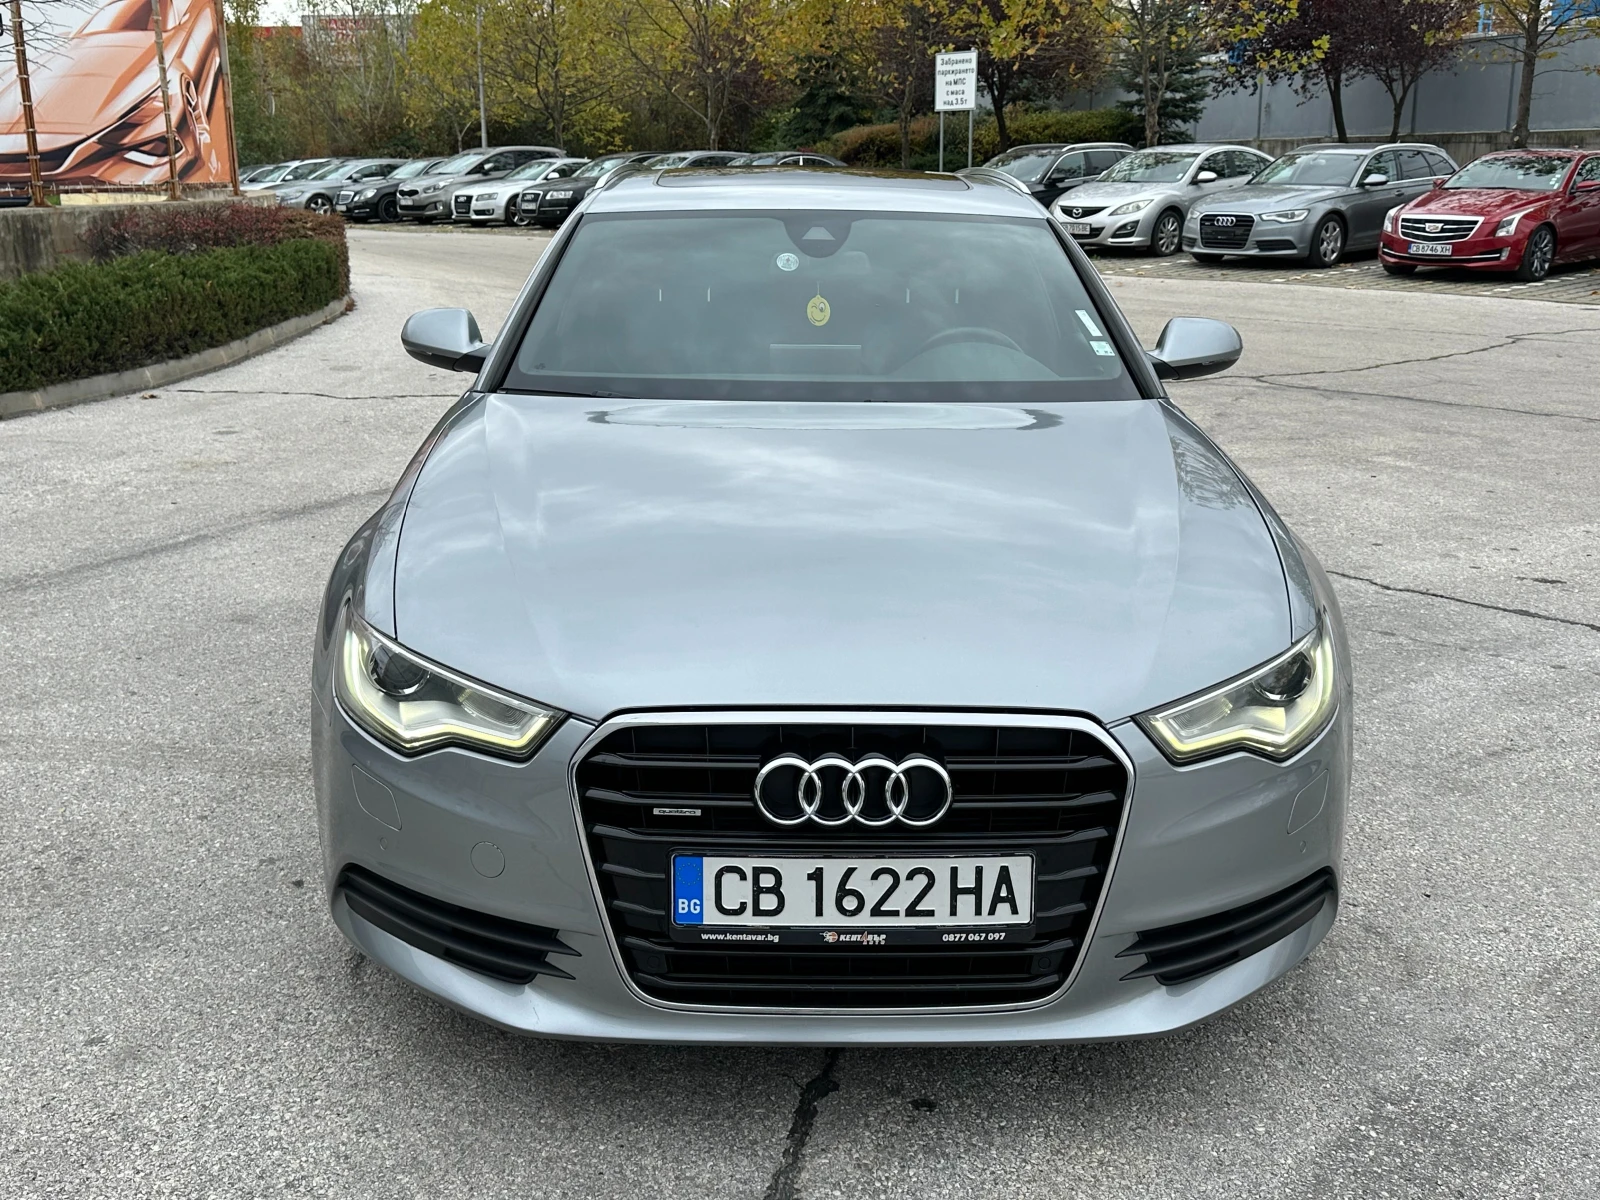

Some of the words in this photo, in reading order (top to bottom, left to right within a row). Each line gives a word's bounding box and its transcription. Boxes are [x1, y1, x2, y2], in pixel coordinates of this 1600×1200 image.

[940, 57, 972, 66] Забранено
[938, 68, 974, 77] паркирането
[953, 78, 966, 86] МПС
[1412, 245, 1420, 253] CB
[1421, 245, 1439, 254] 8746
[1440, 246, 1451, 254] XH
[714, 865, 785, 917] CB
[806, 866, 936, 917] 1622
[950, 865, 1019, 917] HA
[678, 899, 701, 914] BG
[701, 932, 779, 942] www.kentavar.bg
[942, 933, 966, 942] 0877
[967, 933, 986, 941] 067
[987, 932, 1006, 941] 097
